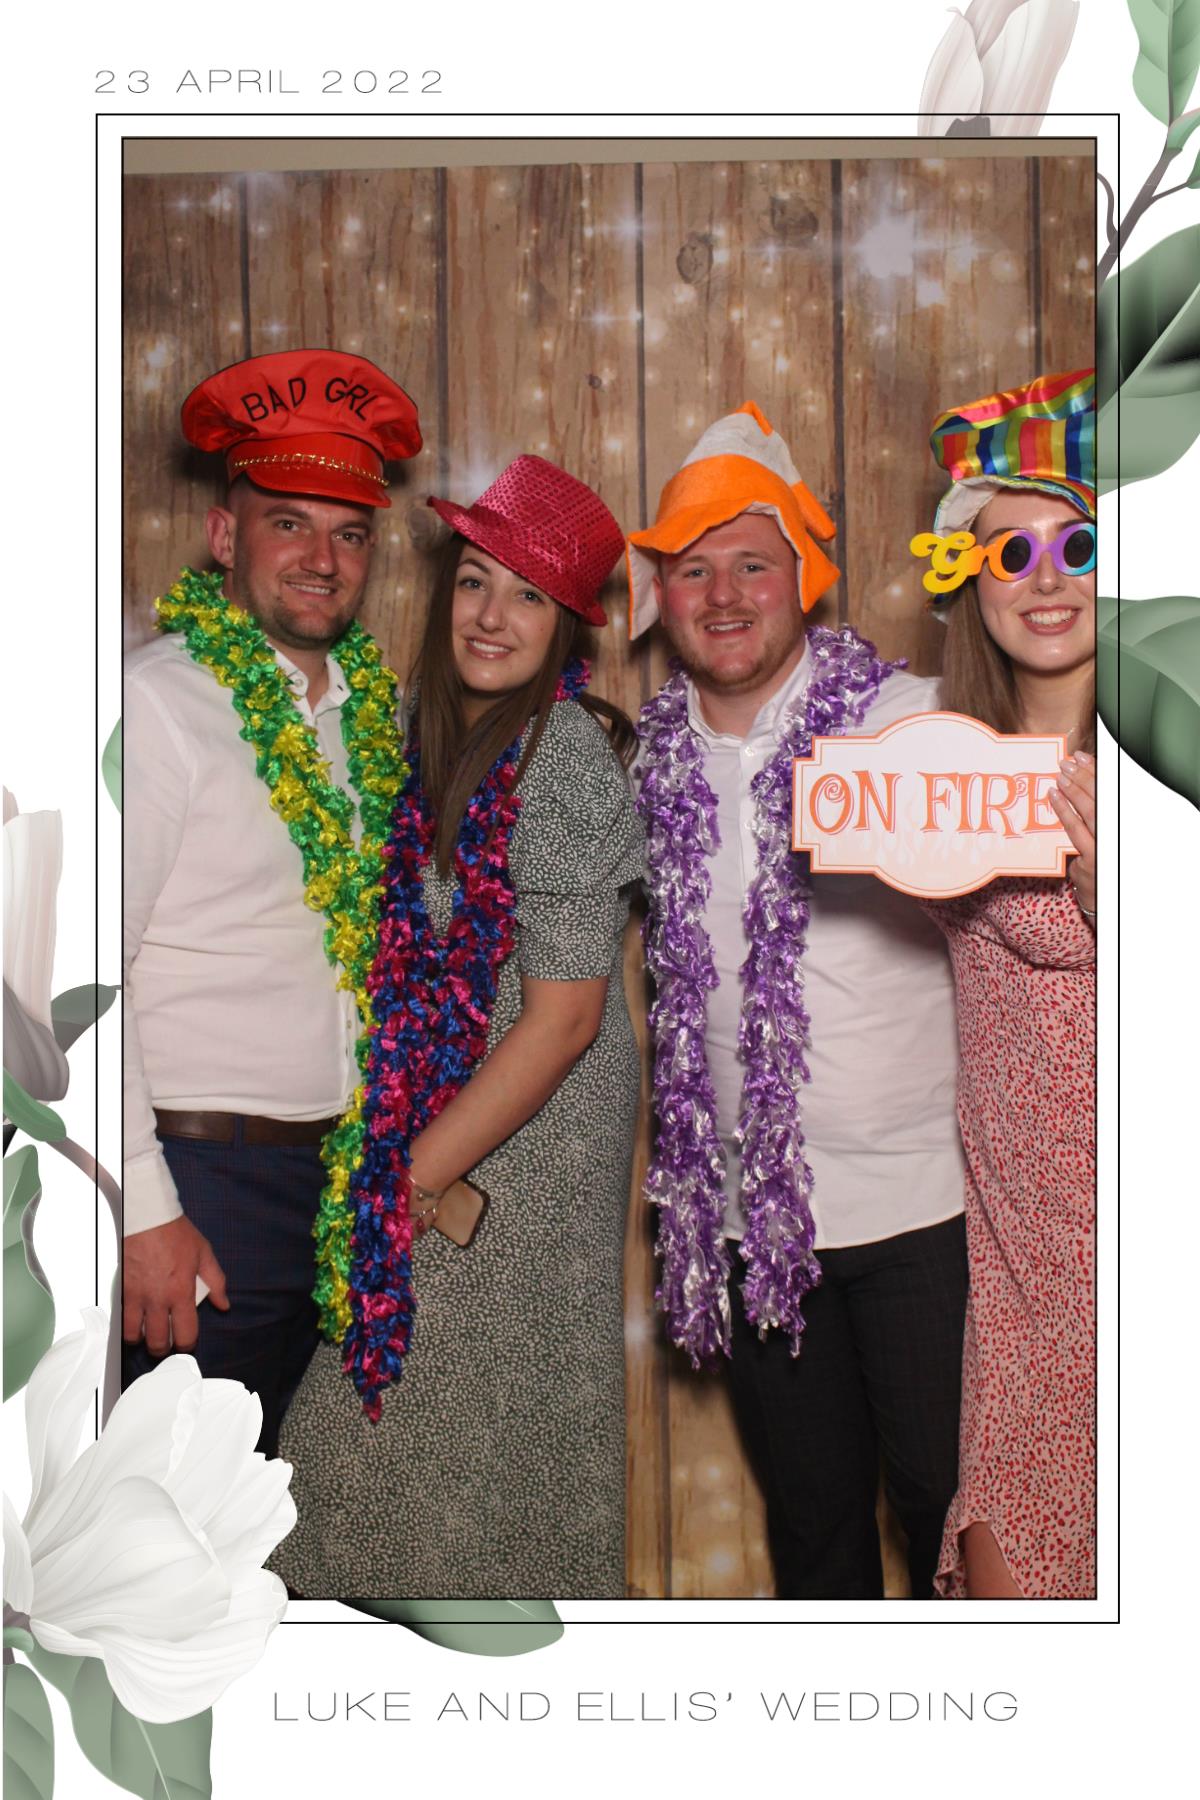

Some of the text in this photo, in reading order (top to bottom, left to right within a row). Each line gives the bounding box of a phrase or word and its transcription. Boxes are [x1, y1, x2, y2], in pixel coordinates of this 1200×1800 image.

[240, 377, 378, 421] BAD GRL
[809, 769, 1065, 839] ON FIRE
